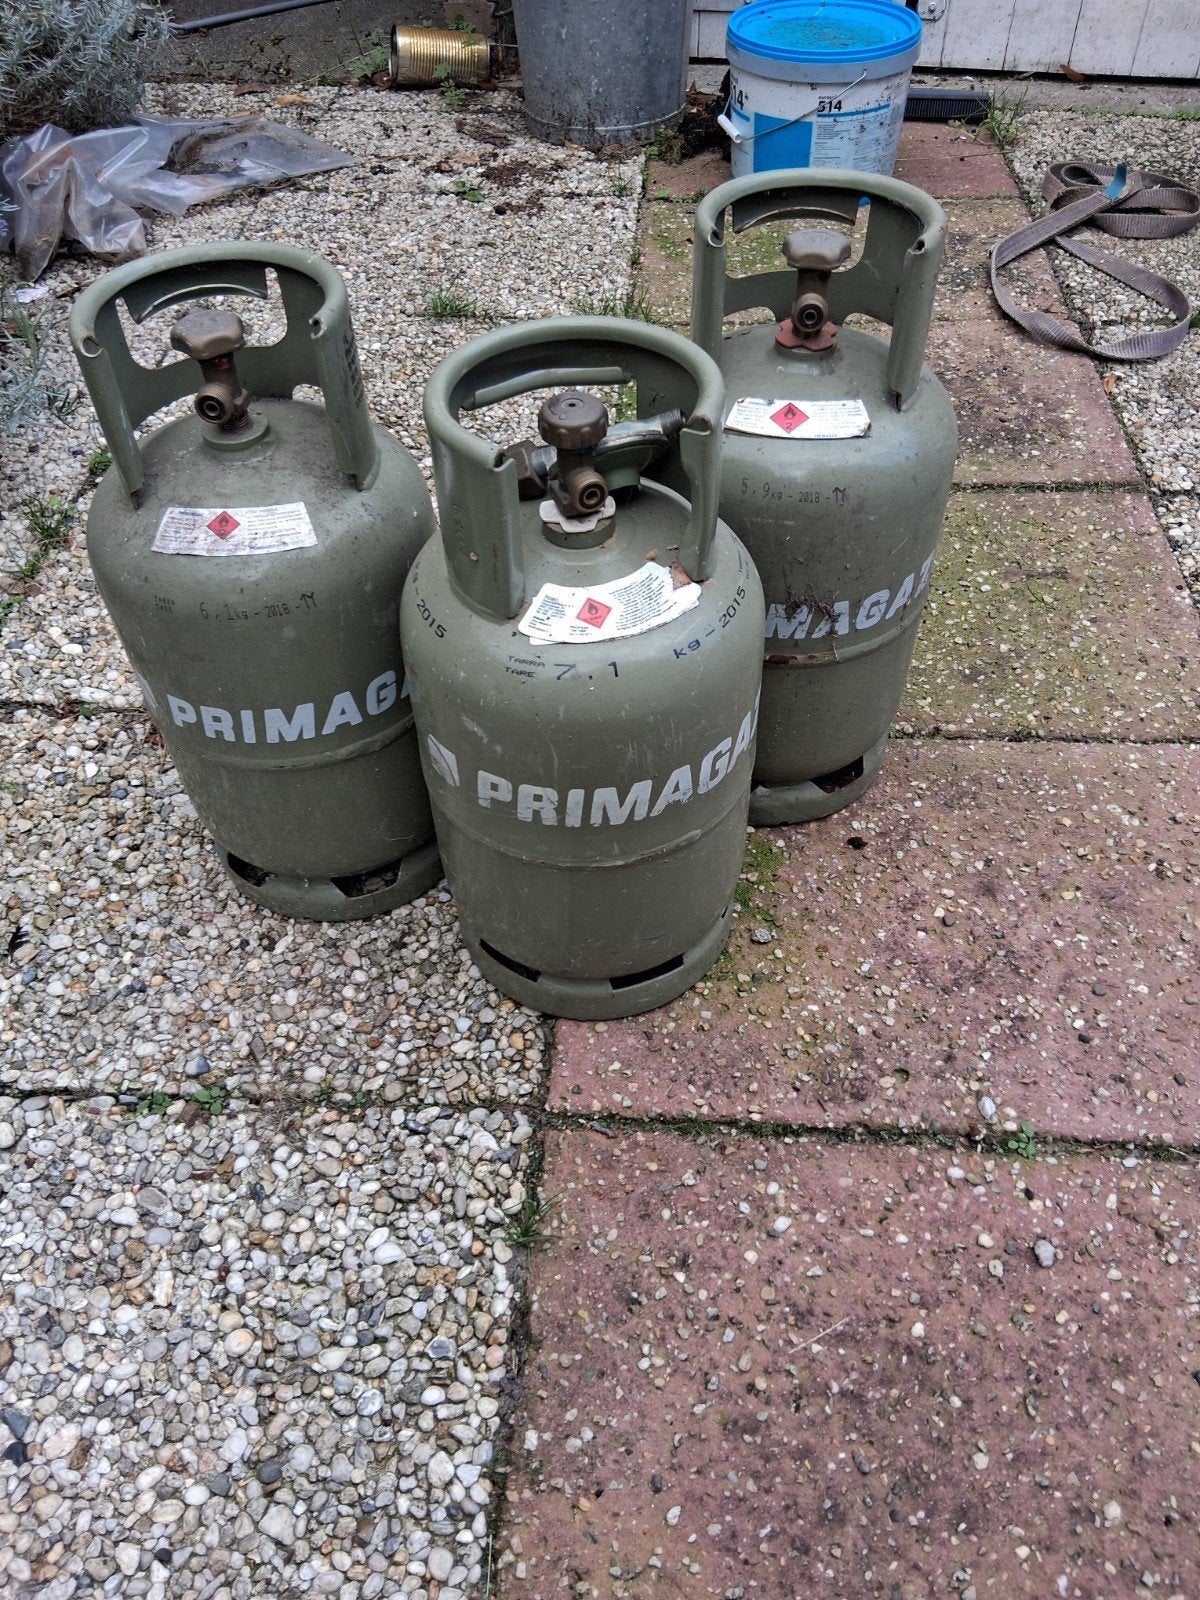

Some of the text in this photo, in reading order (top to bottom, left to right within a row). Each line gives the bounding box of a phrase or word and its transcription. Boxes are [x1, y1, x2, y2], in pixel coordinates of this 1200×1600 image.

[817, 100, 842, 112] 514
[786, 422, 793, 430] 2
[764, 548, 935, 639] MAGAZ
[416, 598, 447, 638] 2015
[507, 655, 546, 669] TARRA
[718, 585, 746, 629] 2015
[504, 665, 537, 678] TARE
[166, 670, 411, 744] PRIMAG
